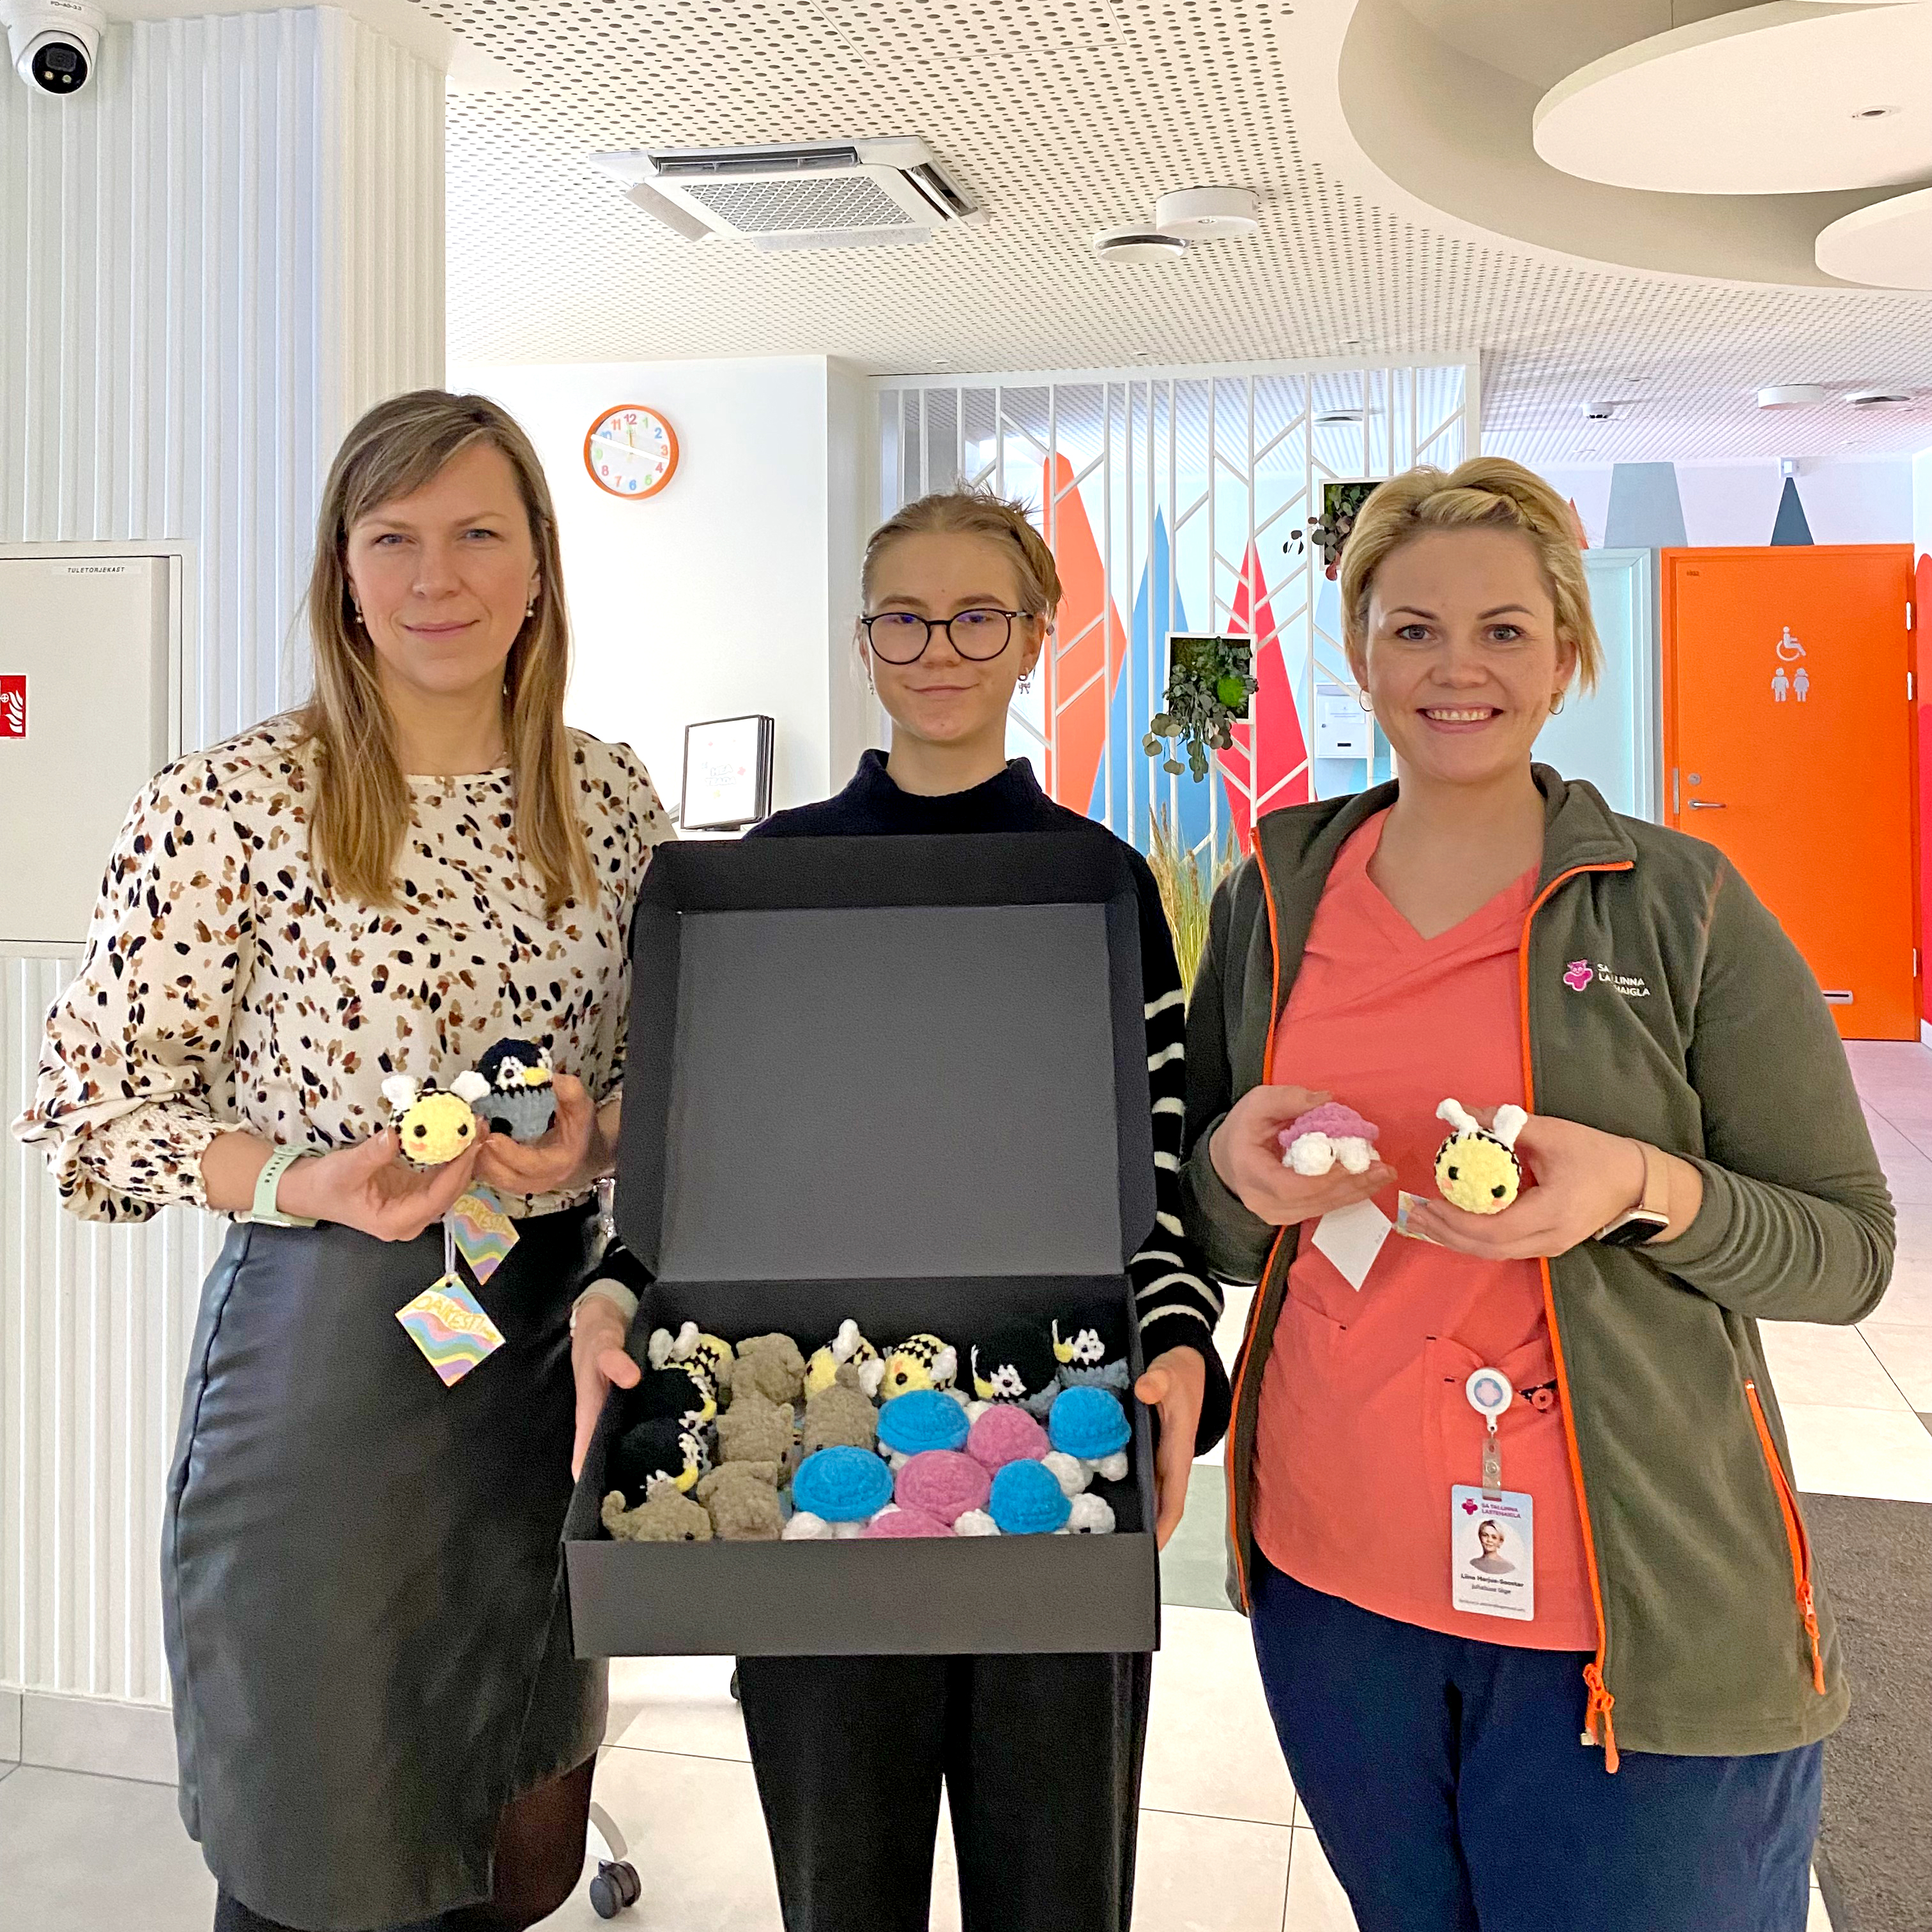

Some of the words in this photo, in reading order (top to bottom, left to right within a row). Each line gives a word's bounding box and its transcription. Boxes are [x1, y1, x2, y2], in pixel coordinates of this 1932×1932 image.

[611, 418, 621, 431] 11
[624, 414, 637, 425] 12
[642, 417, 648, 428] 1
[654, 427, 662, 439] 2
[660, 445, 668, 456] 3
[601, 465, 609, 476] 8
[655, 462, 663, 473] 4
[615, 475, 622, 487] 7
[629, 480, 636, 491] 6
[645, 474, 652, 486] 5
